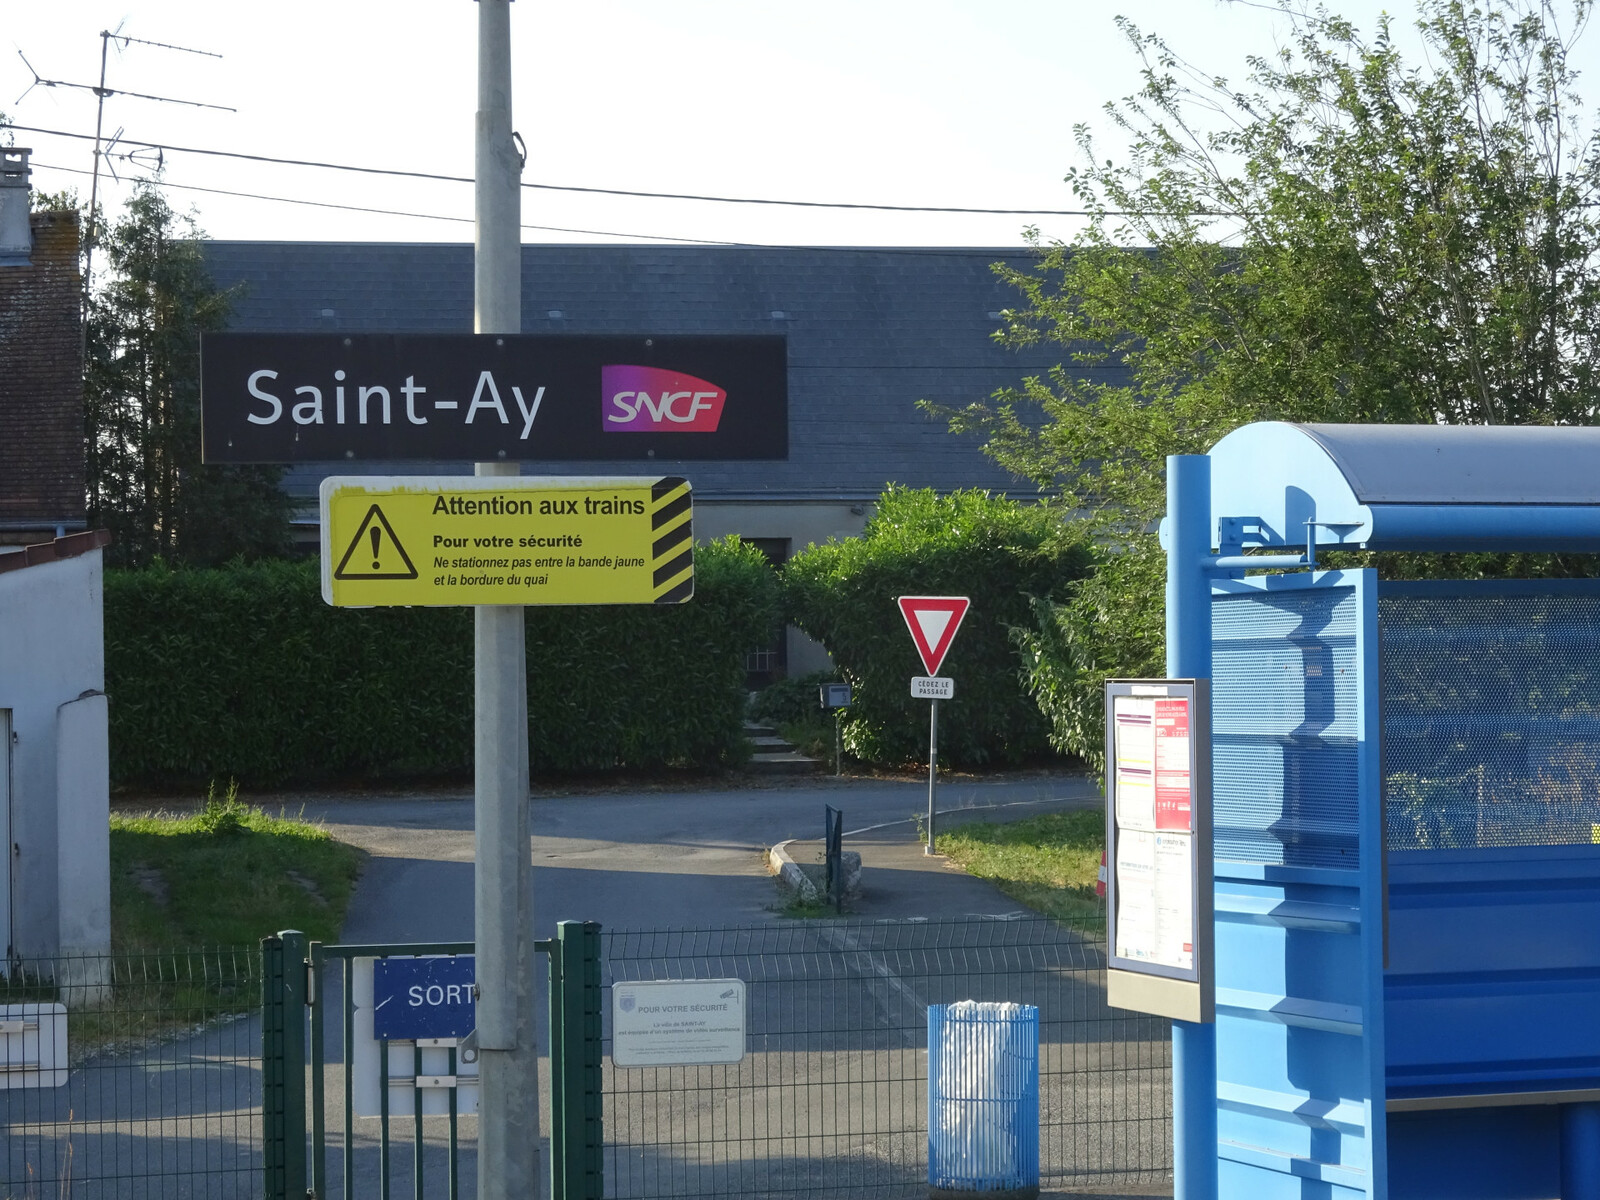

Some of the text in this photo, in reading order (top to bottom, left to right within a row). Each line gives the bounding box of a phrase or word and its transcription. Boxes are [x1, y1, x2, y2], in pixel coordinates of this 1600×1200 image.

[246, 369, 546, 441] Saint-Ay
[607, 391, 719, 423] SNCF
[432, 495, 645, 515] Attention aux trains
[433, 534, 583, 548] Pour votre sécurité
[433, 556, 645, 571] Ne stationnez pas entre la bande jaune
[433, 573, 549, 589] et la bordure du quai
[408, 984, 475, 1006] SORT
[638, 1003, 728, 1014] POUR VOTRE SÉCURITÉ
